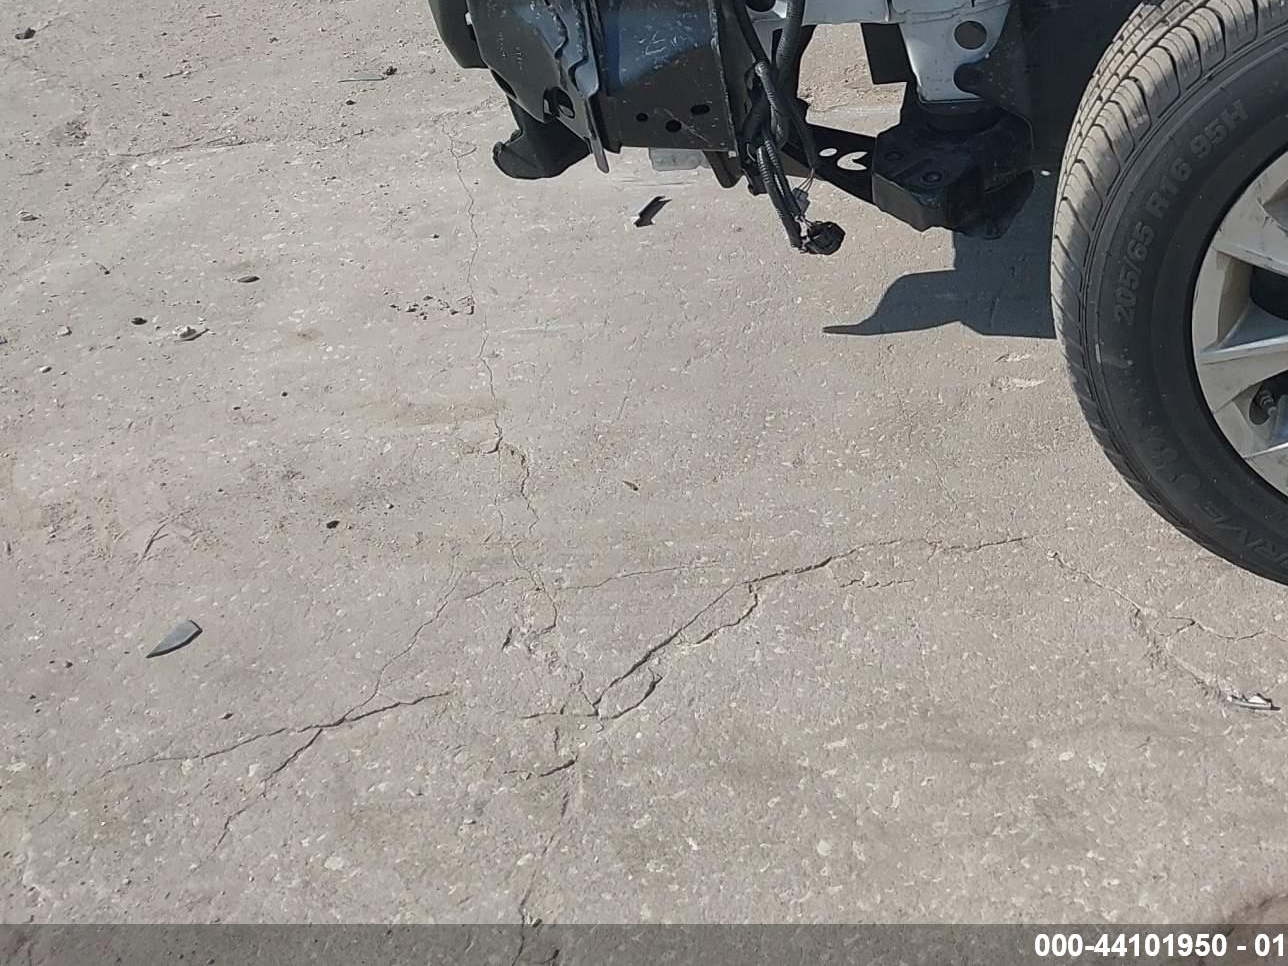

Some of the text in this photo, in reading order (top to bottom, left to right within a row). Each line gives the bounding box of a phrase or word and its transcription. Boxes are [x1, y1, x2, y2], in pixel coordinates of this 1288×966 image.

[1113, 98, 1250, 326] 205/65 R16 95H
